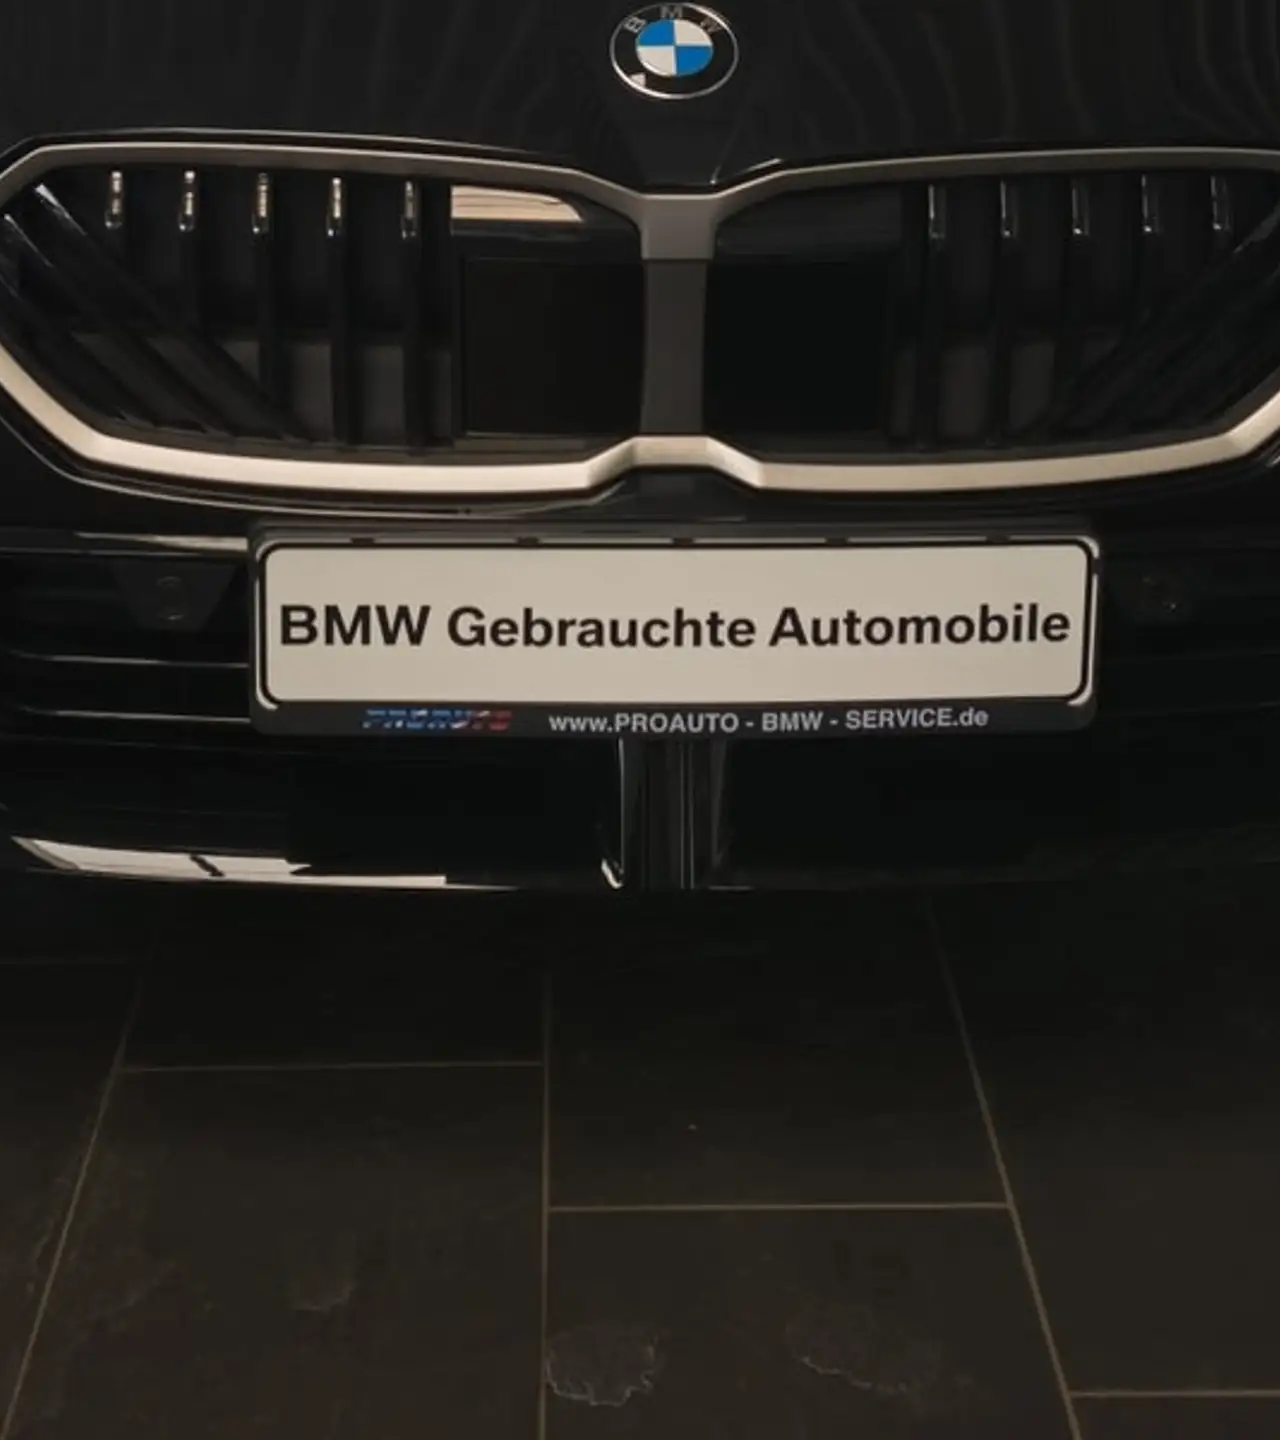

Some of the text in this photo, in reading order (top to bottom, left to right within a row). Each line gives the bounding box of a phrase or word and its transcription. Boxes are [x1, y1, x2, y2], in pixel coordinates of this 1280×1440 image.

[623, 5, 722, 34] BMW
[280, 602, 1072, 648] BMW Gebrauchte Automobile
[549, 712, 740, 733] www.PROAUTO
[761, 712, 824, 731] BMW
[845, 707, 989, 730] SERVICE.de
